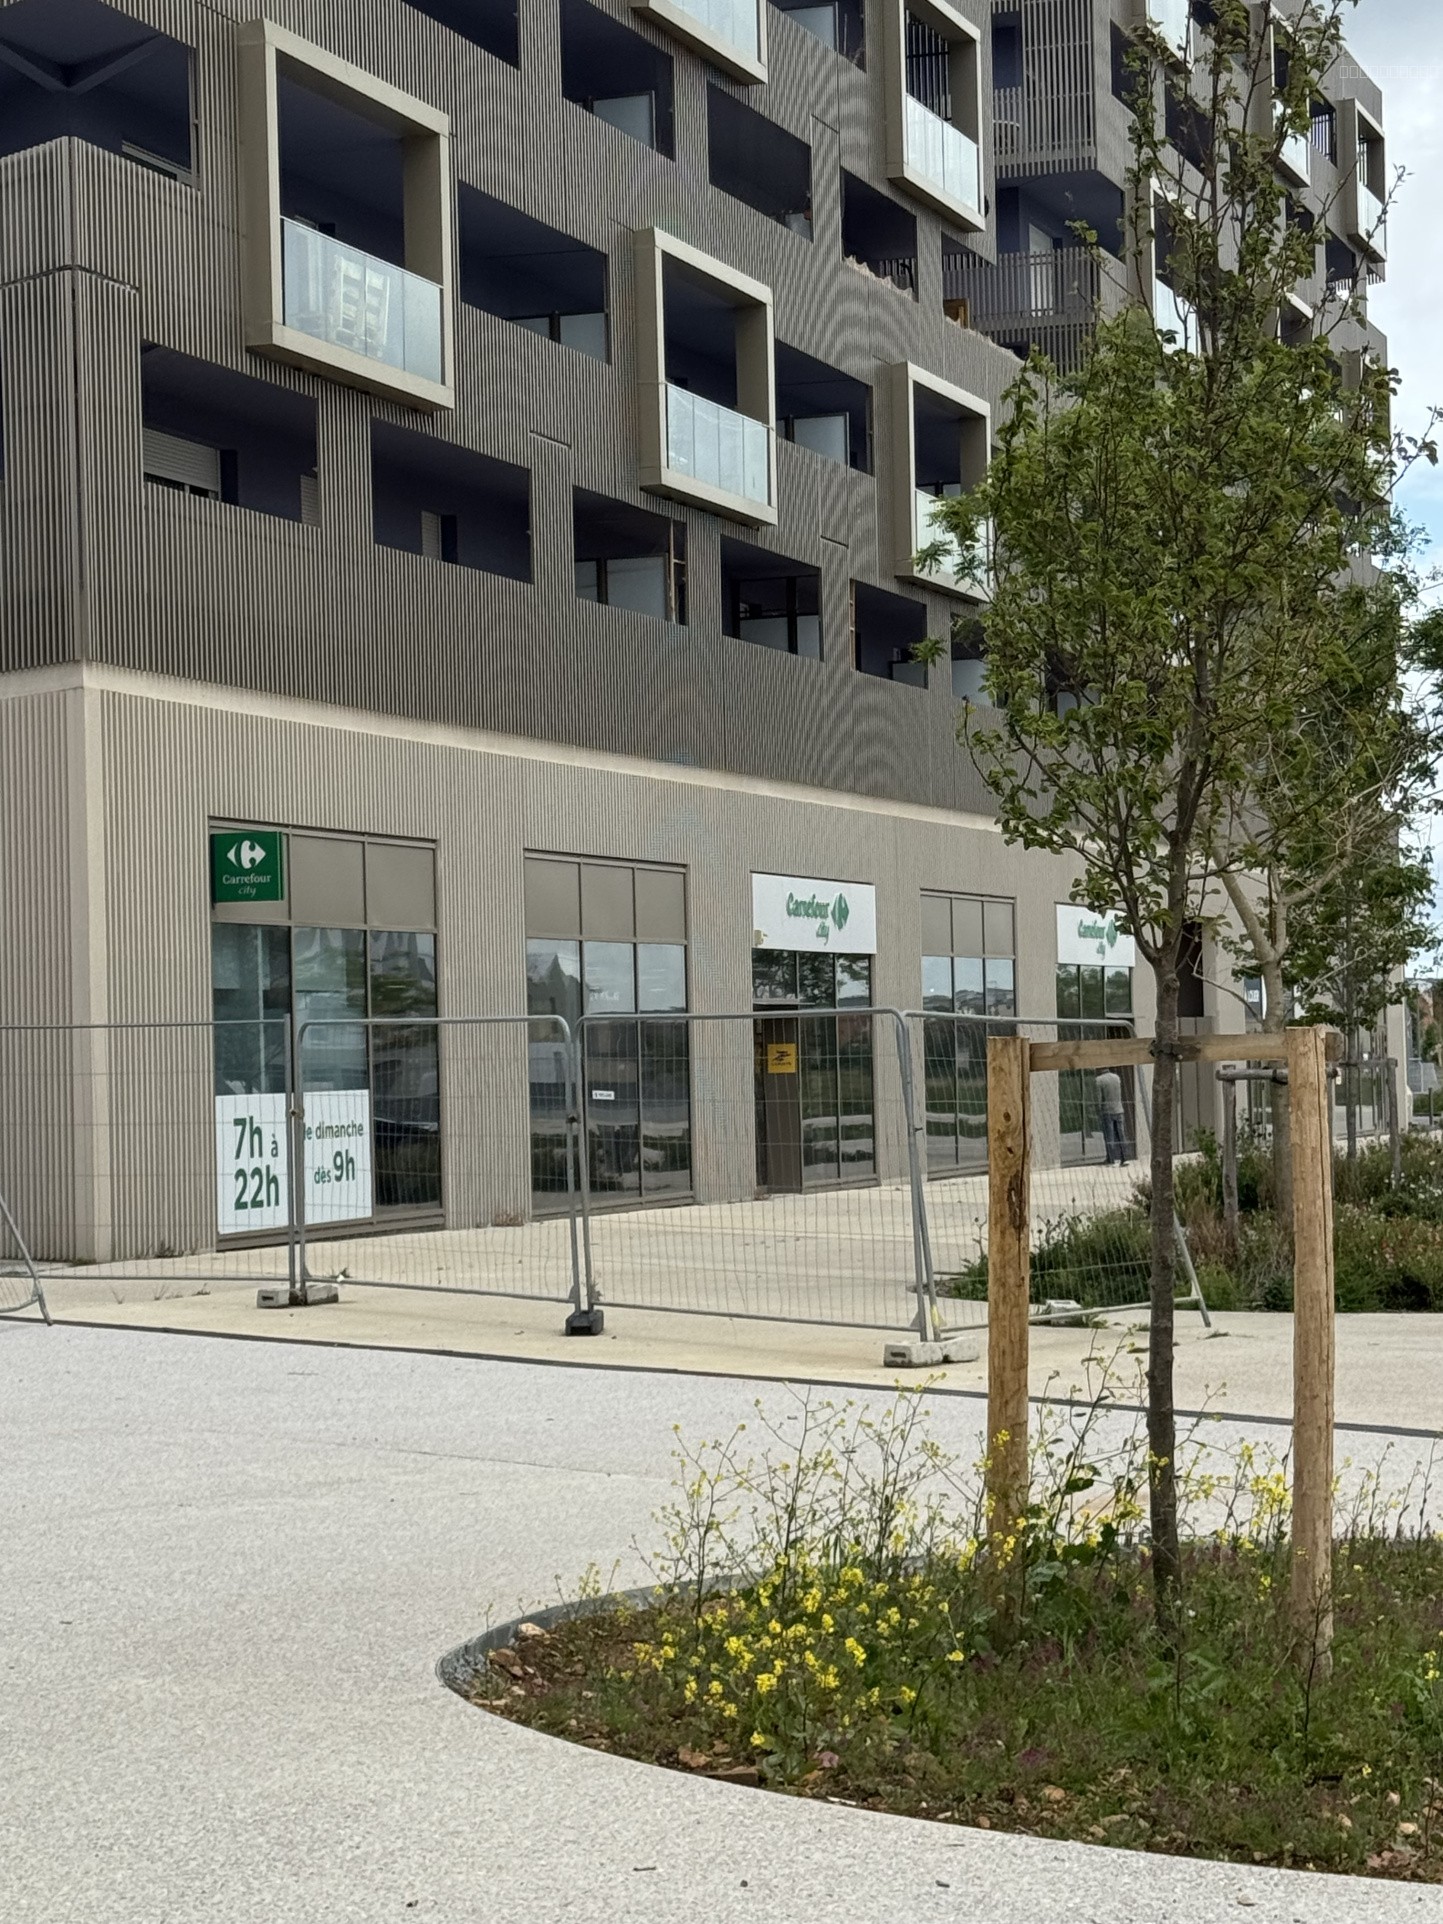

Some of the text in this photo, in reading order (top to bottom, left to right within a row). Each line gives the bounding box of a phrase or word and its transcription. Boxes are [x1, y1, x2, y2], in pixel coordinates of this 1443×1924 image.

[222, 873, 271, 884] Carrefour
[238, 886, 256, 897] city
[233, 1116, 279, 1160] 7h à
[315, 1120, 363, 1139] dimanche
[314, 1149, 355, 1184] dès 9h
[234, 1165, 279, 1210] 22h
